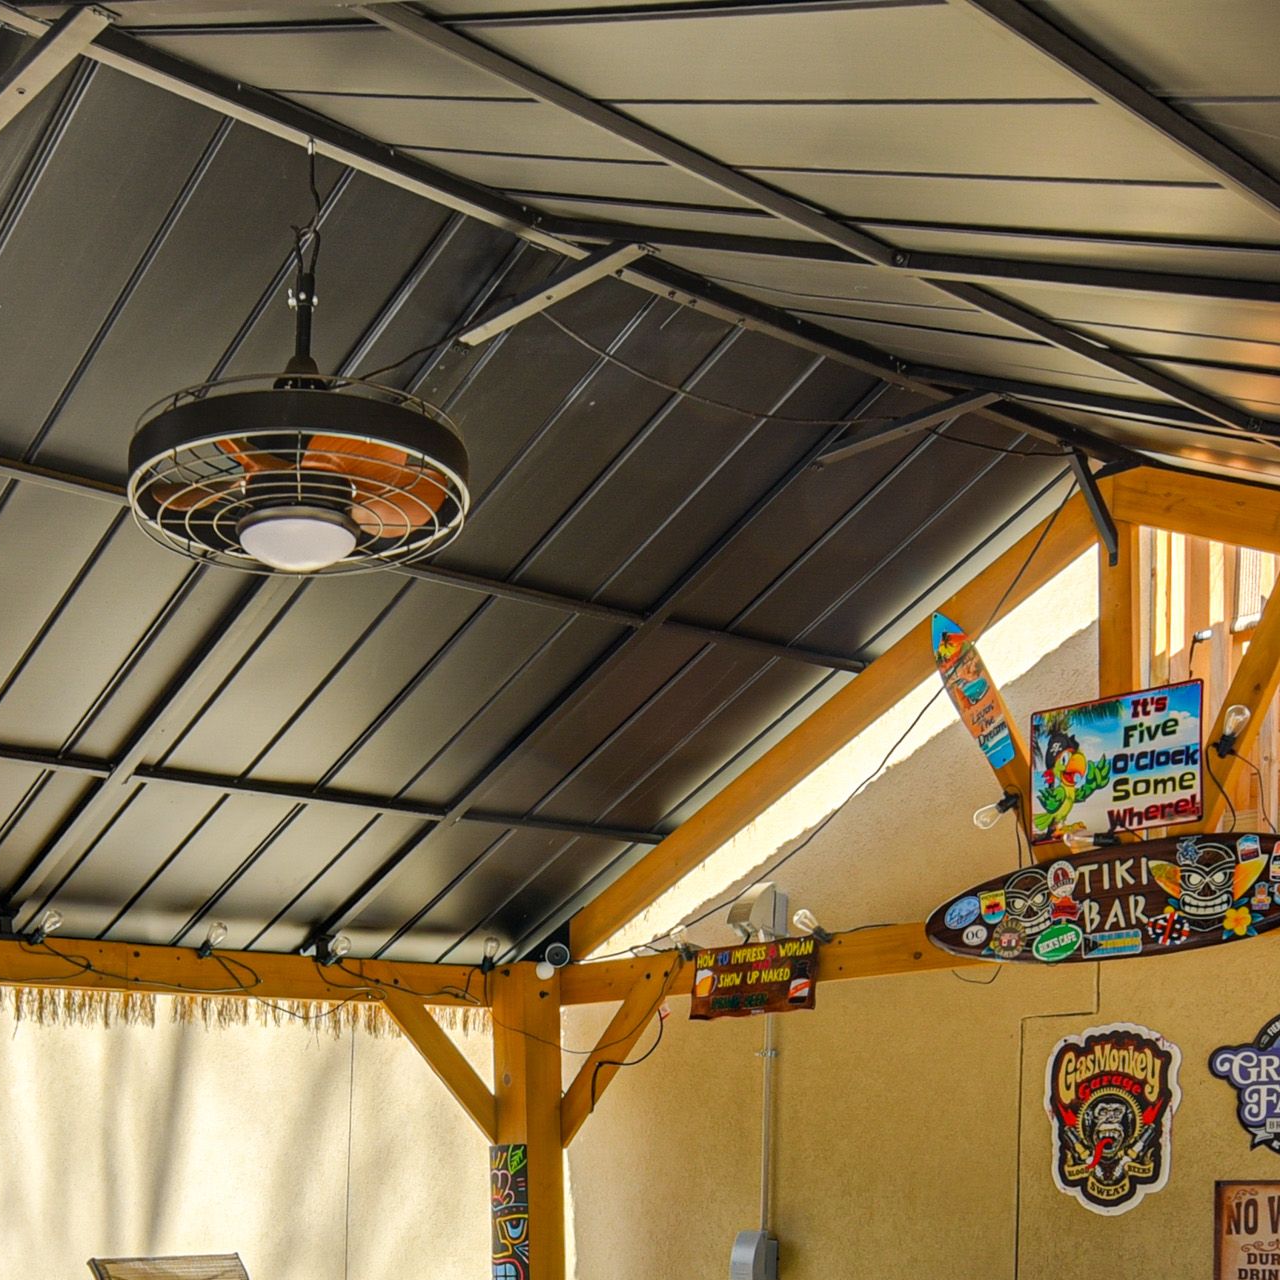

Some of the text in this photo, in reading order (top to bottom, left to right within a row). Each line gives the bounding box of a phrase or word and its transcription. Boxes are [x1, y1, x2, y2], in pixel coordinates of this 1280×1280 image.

[1131, 696, 1168, 718] It's
[977, 721, 1007, 747] Dream
[1123, 718, 1179, 748] Five
[1112, 745, 1199, 775] O'Clock
[1112, 771, 1196, 802] Some
[1107, 794, 1200, 829] Where!
[1077, 857, 1149, 893] TIKI
[1083, 894, 1148, 933] BAR
[965, 926, 984, 941] OC
[697, 953, 716, 968] HOW
[717, 950, 730, 966] TO
[731, 946, 767, 964] IMPRESS
[779, 940, 814, 957] WOMAN
[718, 968, 791, 988] SHOW UP NAKED
[1078, 1074, 1143, 1101] Garage
[1090, 1181, 1128, 1198] SWEAT
[1225, 1198, 1259, 1236] NO
